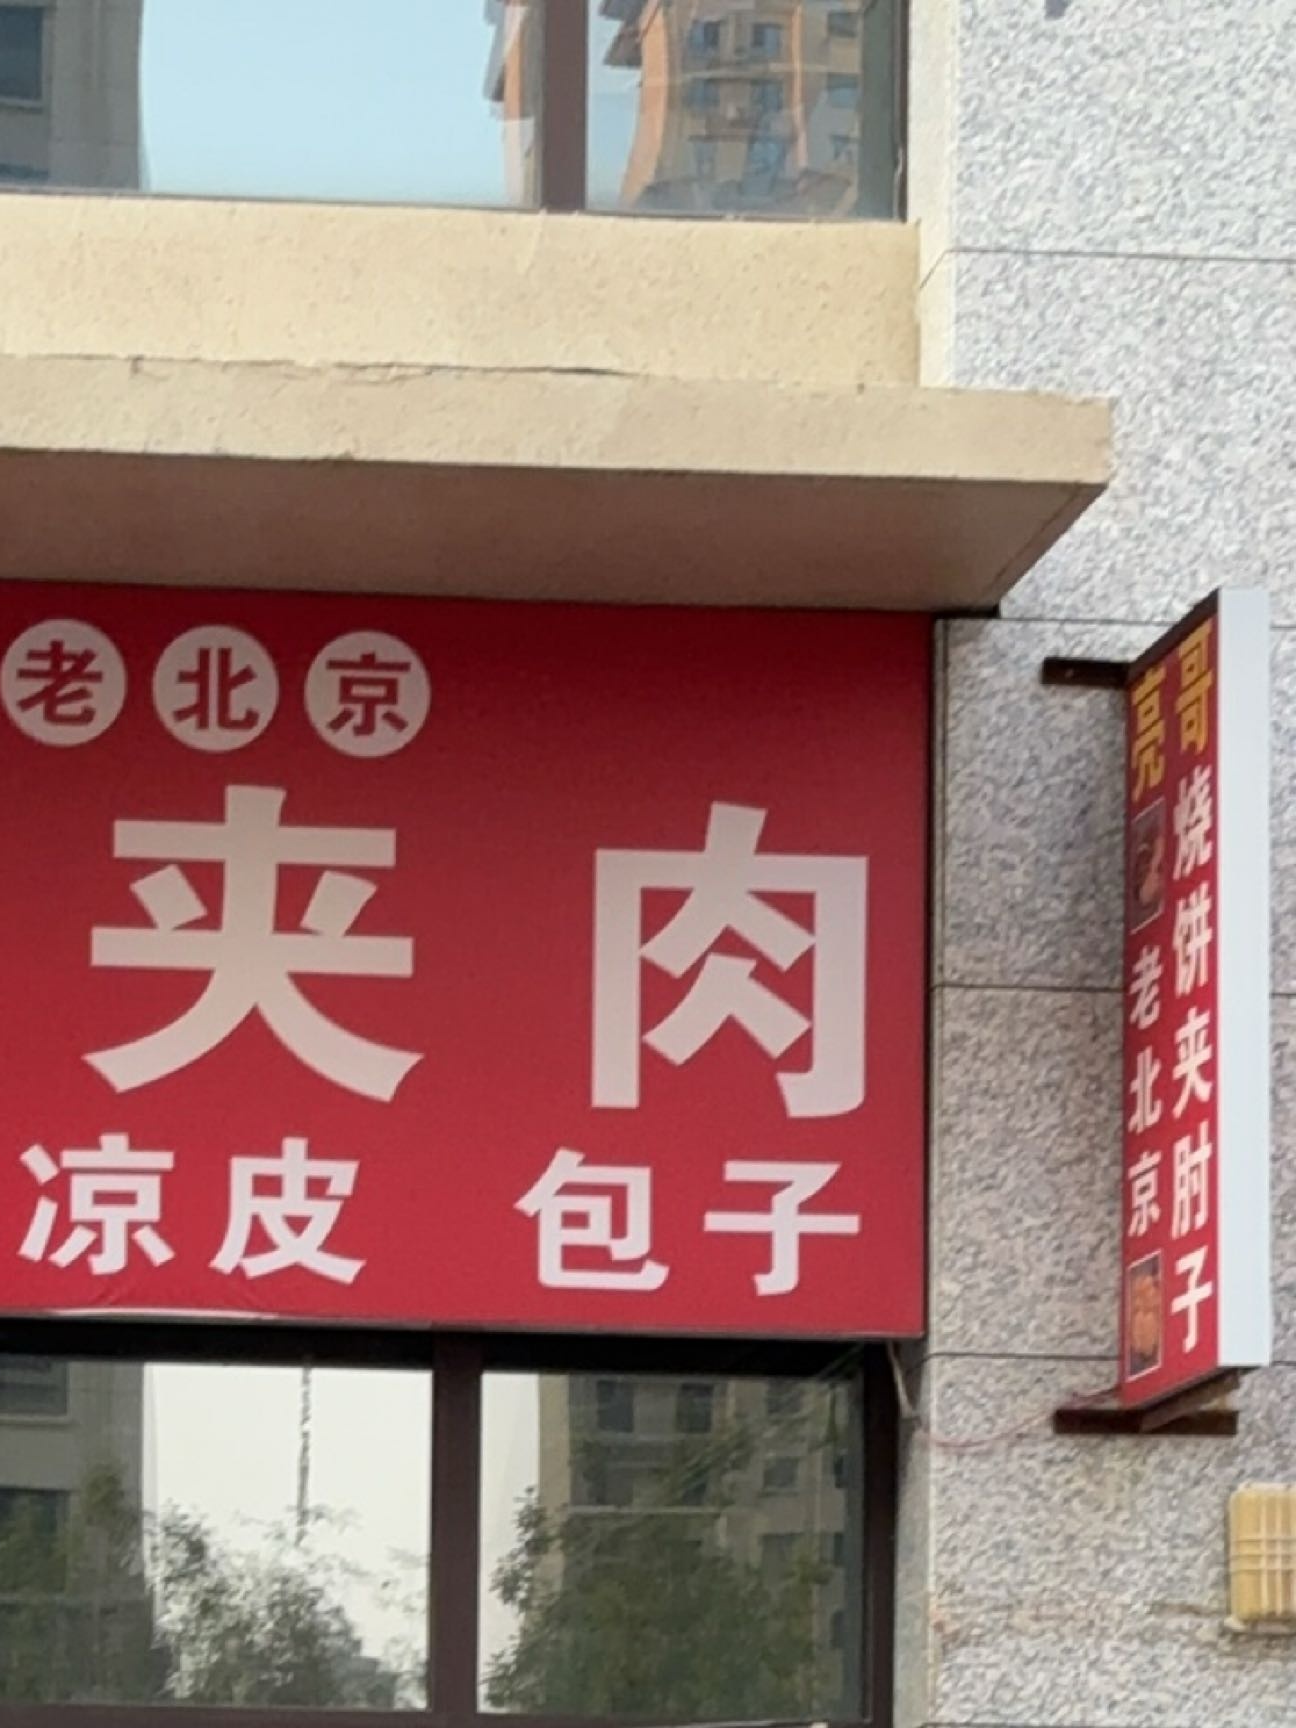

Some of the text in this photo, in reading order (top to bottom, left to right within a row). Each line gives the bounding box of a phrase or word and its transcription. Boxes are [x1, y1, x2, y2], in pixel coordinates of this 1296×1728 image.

[1131, 617, 1214, 801] 亮哥
[1127, 943, 1163, 1239] 老北京
[1170, 764, 1214, 1353] 烧饼夹肘子
[17, 1132, 367, 1285] 凉皮
[513, 1146, 862, 1298] 包子
